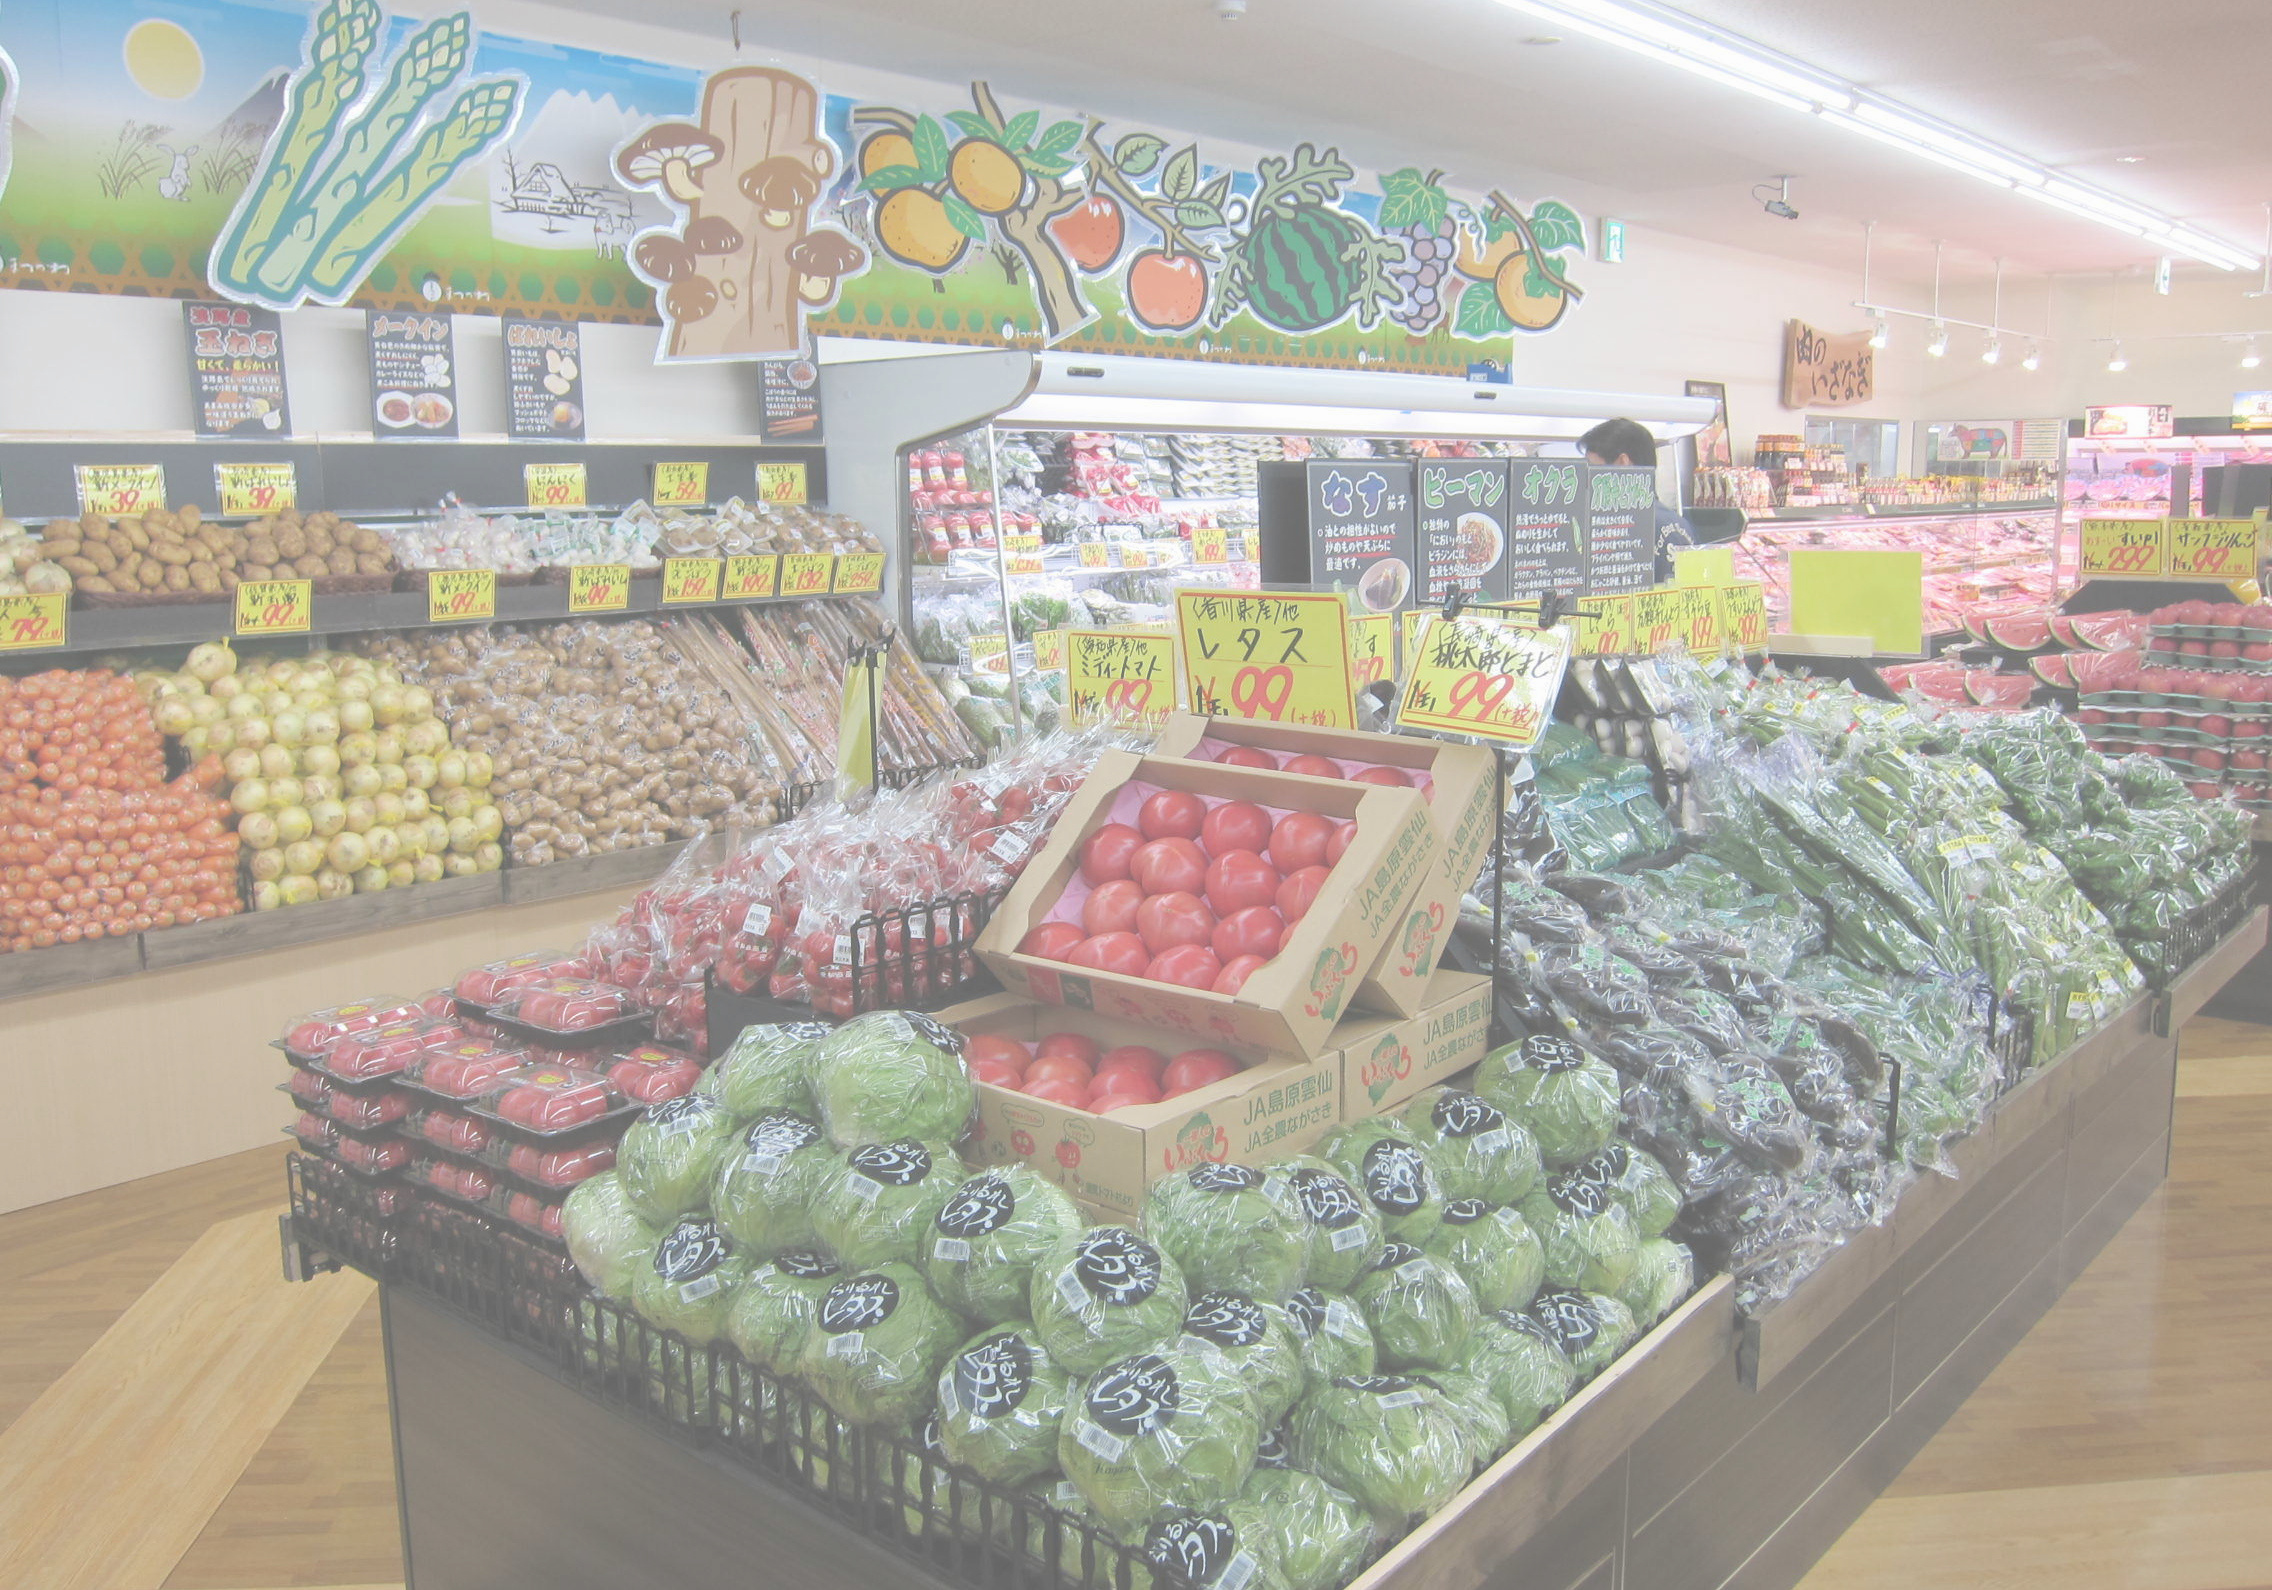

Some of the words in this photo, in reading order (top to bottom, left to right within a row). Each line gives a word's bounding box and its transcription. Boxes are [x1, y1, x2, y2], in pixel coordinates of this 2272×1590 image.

[373, 315, 449, 340] メークイン
[508, 324, 578, 350] ばれいしょ
[195, 327, 278, 358] 玉ねぎ
[1796, 323, 1827, 366] 肉の
[545, 484, 570, 505] 99
[675, 481, 698, 501] 59
[775, 482, 794, 501] 99
[1320, 469, 1388, 519] なす
[1387, 495, 1407, 512] 茄子
[1423, 467, 1505, 510] ピーマン
[1522, 464, 1579, 505] オクラ
[111, 489, 141, 513] 39
[248, 486, 277, 510] 39
[1324, 523, 1397, 539] 油との相性がよいので
[1324, 540, 1392, 555] 炒めものや天ぷらに
[2107, 545, 2156, 571] 299
[2192, 546, 2230, 573] 99
[1325, 556, 1362, 572] 最適です。
[587, 584, 612, 605] 99
[680, 577, 708, 597] 159
[262, 603, 295, 627] 99
[451, 591, 477, 614] 99
[10, 616, 50, 642] 79
[1197, 627, 1309, 664] レタス
[1430, 643, 1555, 678] 桃太郎とまと
[1105, 678, 1153, 720] 99
[1231, 665, 1294, 721] 99
[1449, 671, 1515, 722] 99
[1243, 1070, 1333, 1126] JA島原雲仙
